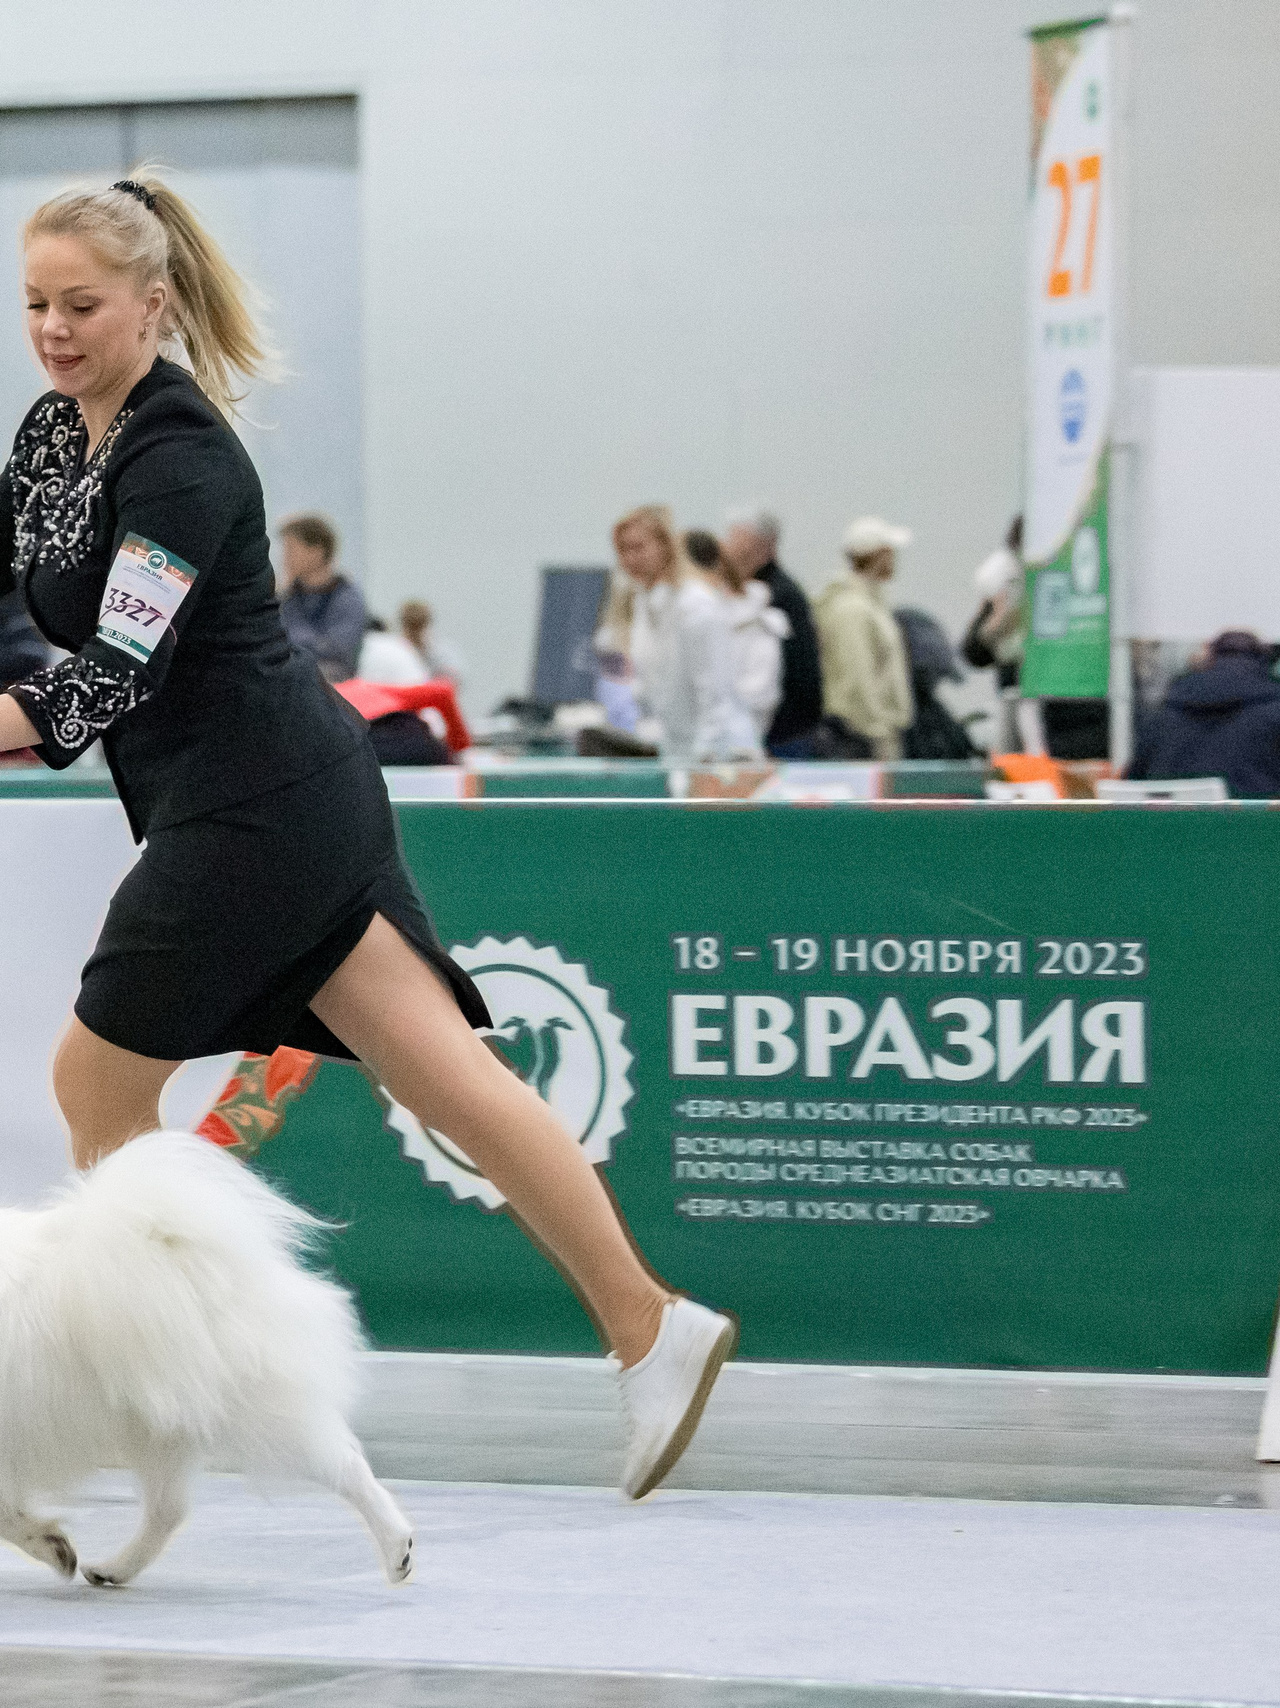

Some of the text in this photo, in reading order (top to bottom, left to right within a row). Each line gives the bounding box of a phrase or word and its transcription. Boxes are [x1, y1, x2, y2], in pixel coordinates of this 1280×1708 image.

[1047, 153, 1102, 299] 27
[105, 587, 163, 627] 3327
[673, 937, 720, 970] 18
[772, 938, 819, 970] 19
[835, 939, 1021, 973] НОЯБРЯ
[1038, 941, 1144, 975] 2023
[672, 995, 1146, 1083] ЕВРАЗИЯ
[794, 1102, 871, 1121] КУБОК
[874, 1103, 1029, 1126] ПРЕЗИДЕНТА
[1031, 1107, 1081, 1125] РКФ
[675, 1136, 1032, 1162] ВСЕМИРНАЯ ВЫСТАВКА СОБАК
[795, 1202, 872, 1220] КУБОК
[876, 1203, 923, 1221] СНГ
